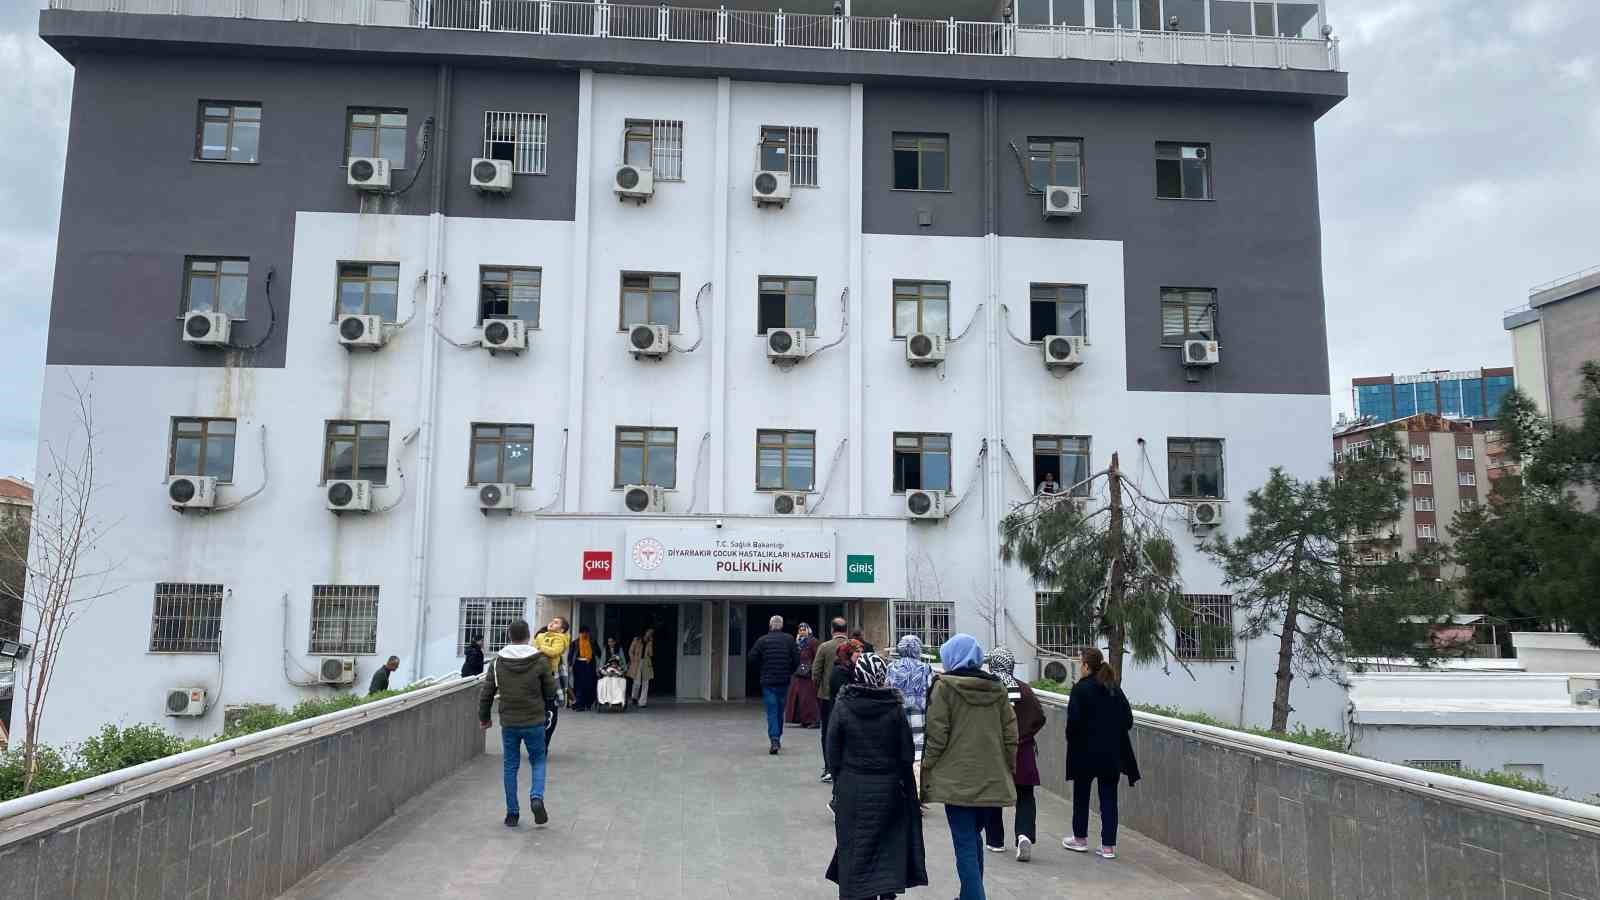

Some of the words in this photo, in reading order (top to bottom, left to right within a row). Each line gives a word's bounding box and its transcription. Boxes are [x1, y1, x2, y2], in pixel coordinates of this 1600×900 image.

[716, 540, 729, 548] T.C.
[752, 541, 784, 550] Baanl
[713, 550, 737, 558] ÇOCUK
[739, 550, 790, 559] HASTALIKLARI
[791, 550, 831, 559] HASTANESİ
[585, 559, 610, 572] ÇIKIŞ
[716, 559, 783, 573] POLİKLİNİK
[848, 562, 873, 575] GİRİŞ
